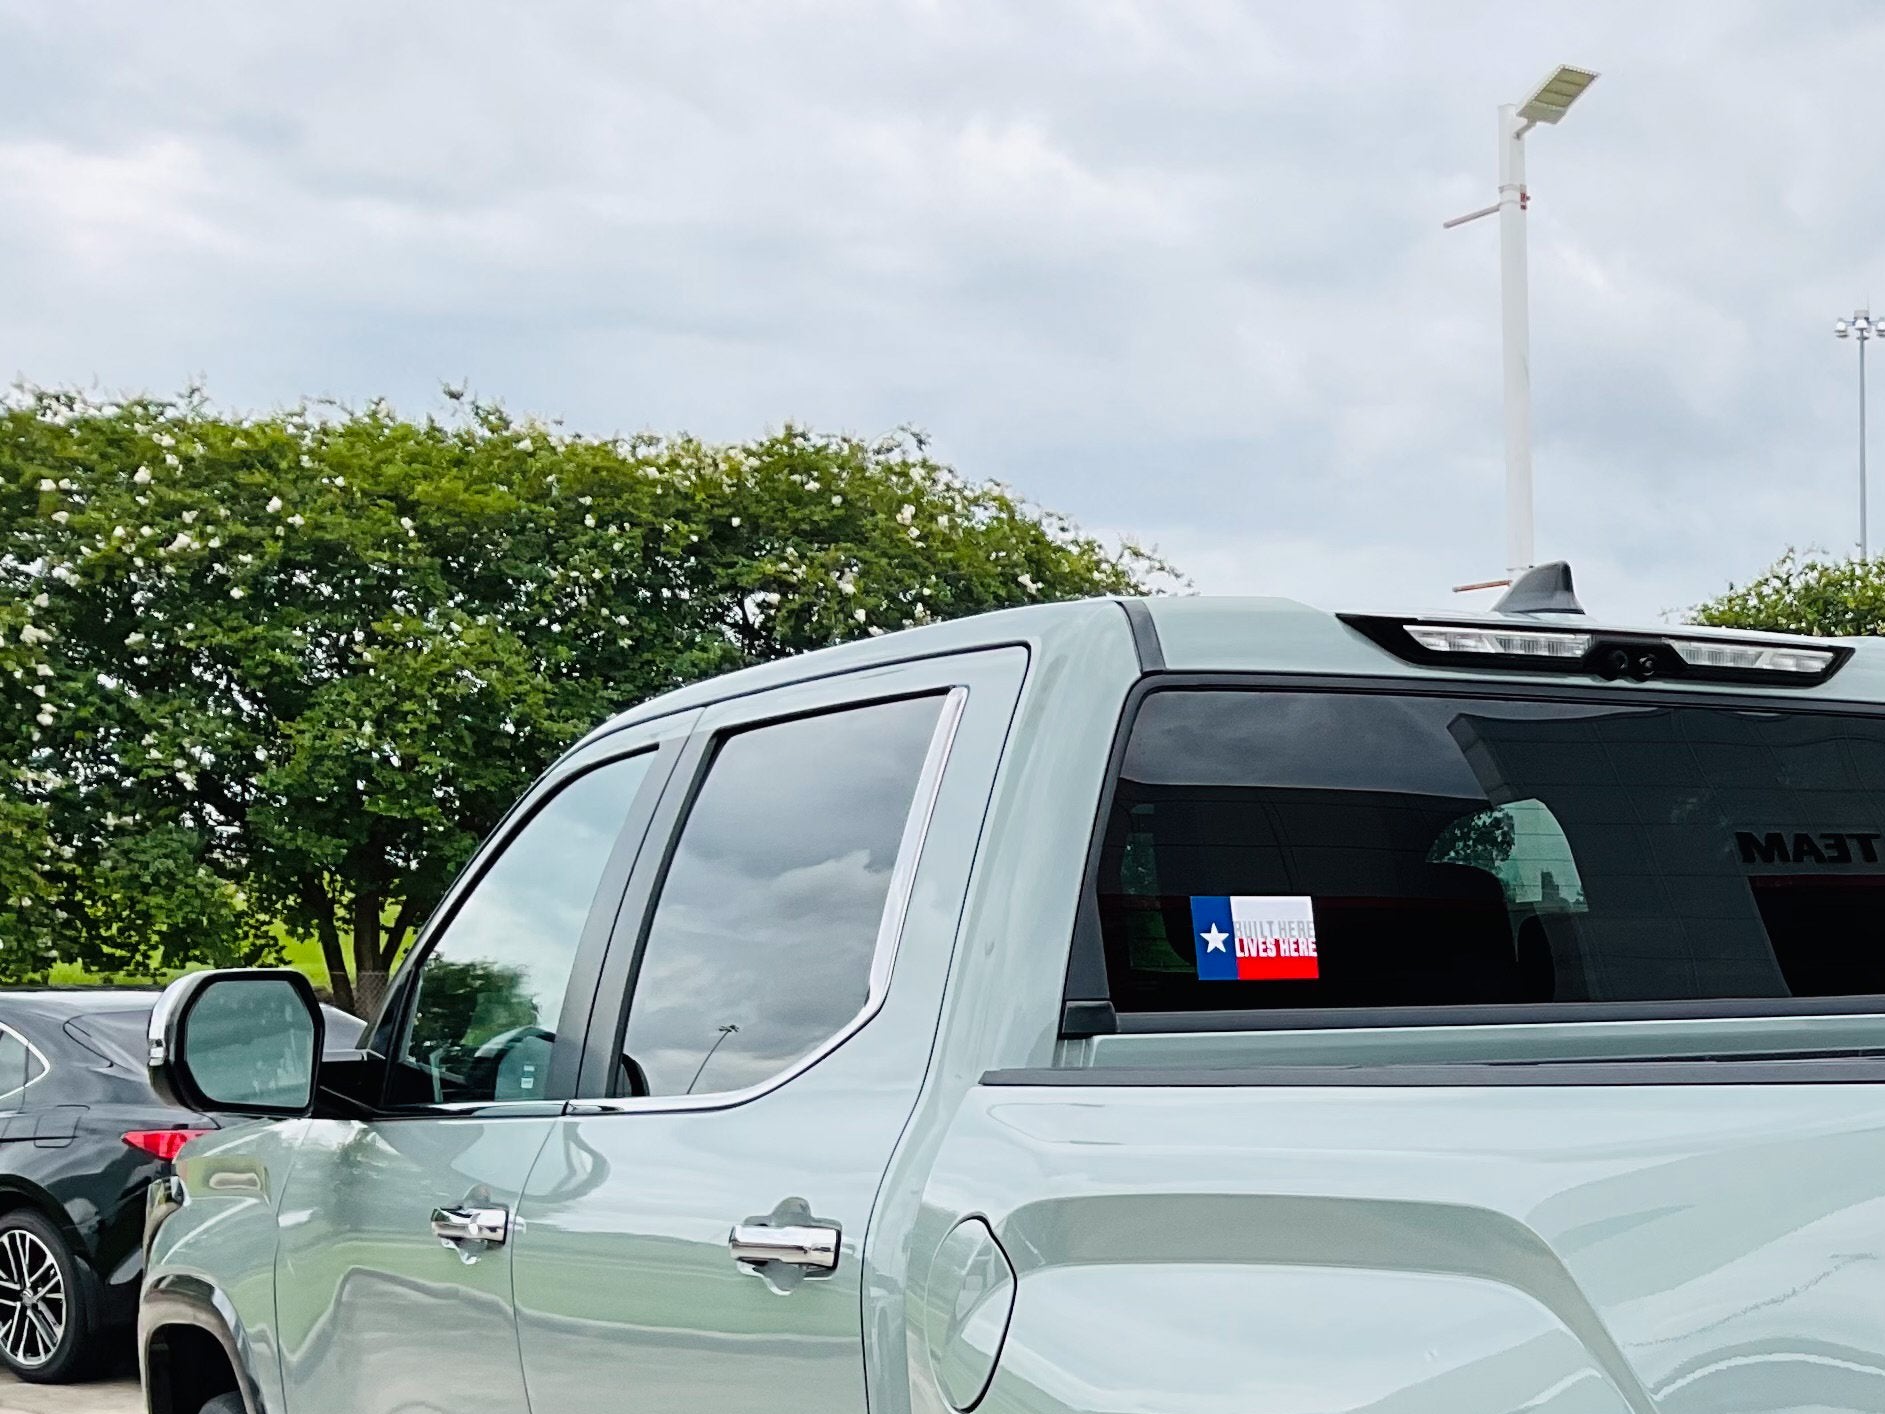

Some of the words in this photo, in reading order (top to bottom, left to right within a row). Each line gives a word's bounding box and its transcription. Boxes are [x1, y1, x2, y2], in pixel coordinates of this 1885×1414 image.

[1235, 920, 1275, 938] BUILT
[1277, 920, 1314, 938] HERE
[1235, 938, 1277, 957] LIVES
[1279, 938, 1317, 957] HERE
